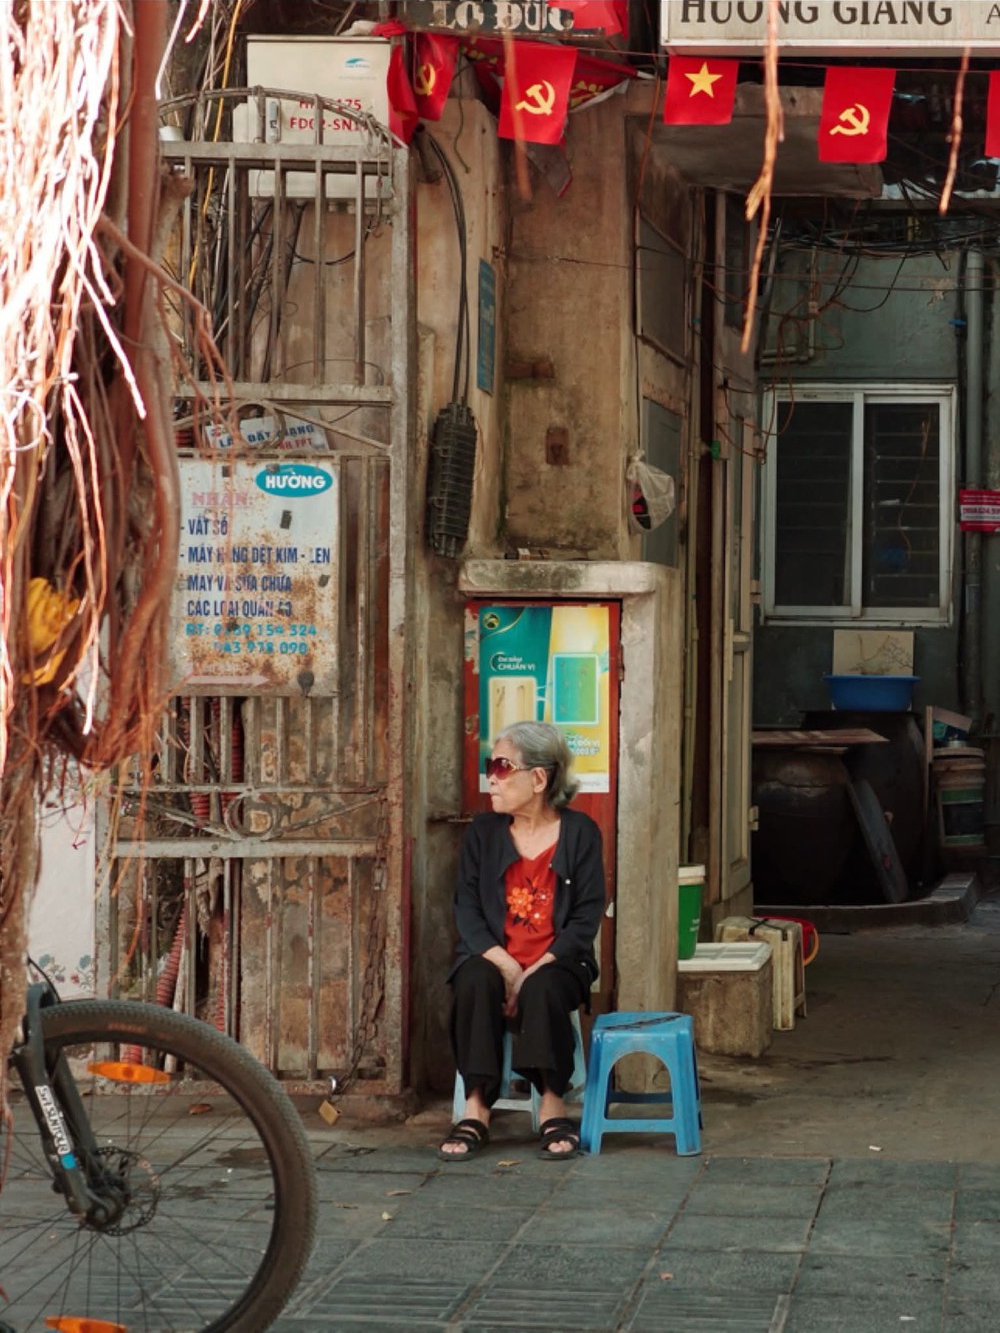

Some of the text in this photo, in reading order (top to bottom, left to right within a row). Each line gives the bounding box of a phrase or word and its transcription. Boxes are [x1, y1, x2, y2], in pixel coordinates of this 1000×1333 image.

[833, 0, 952, 26] GIANG
[265, 471, 326, 489] HƯỜNG
[216, 546, 248, 563] HNG
[276, 547, 298, 563] KIM
[213, 623, 251, 637] 09
